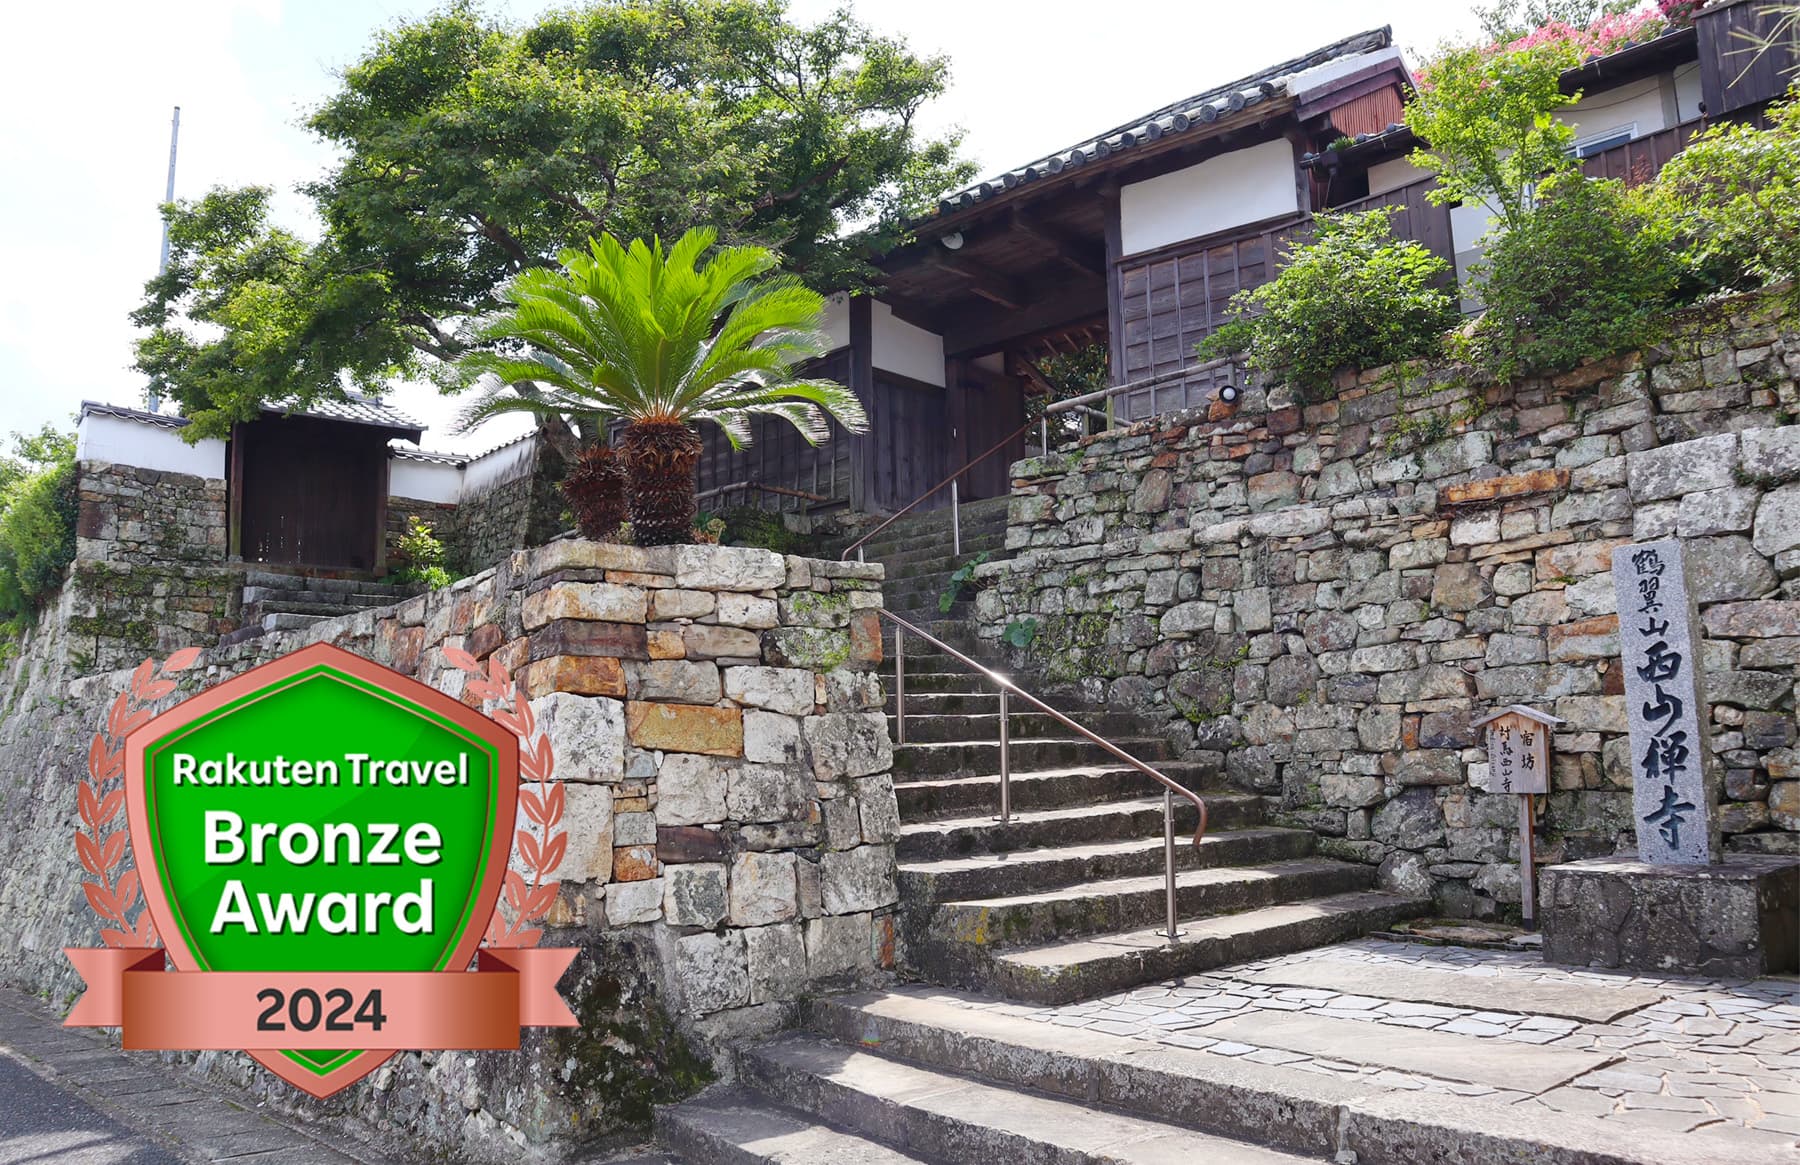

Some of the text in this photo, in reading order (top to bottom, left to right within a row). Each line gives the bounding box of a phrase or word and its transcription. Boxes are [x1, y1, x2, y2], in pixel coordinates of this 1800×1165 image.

[1500, 725, 1513, 792] 対馬西山寺
[1520, 730, 1535, 771] 宿坊
